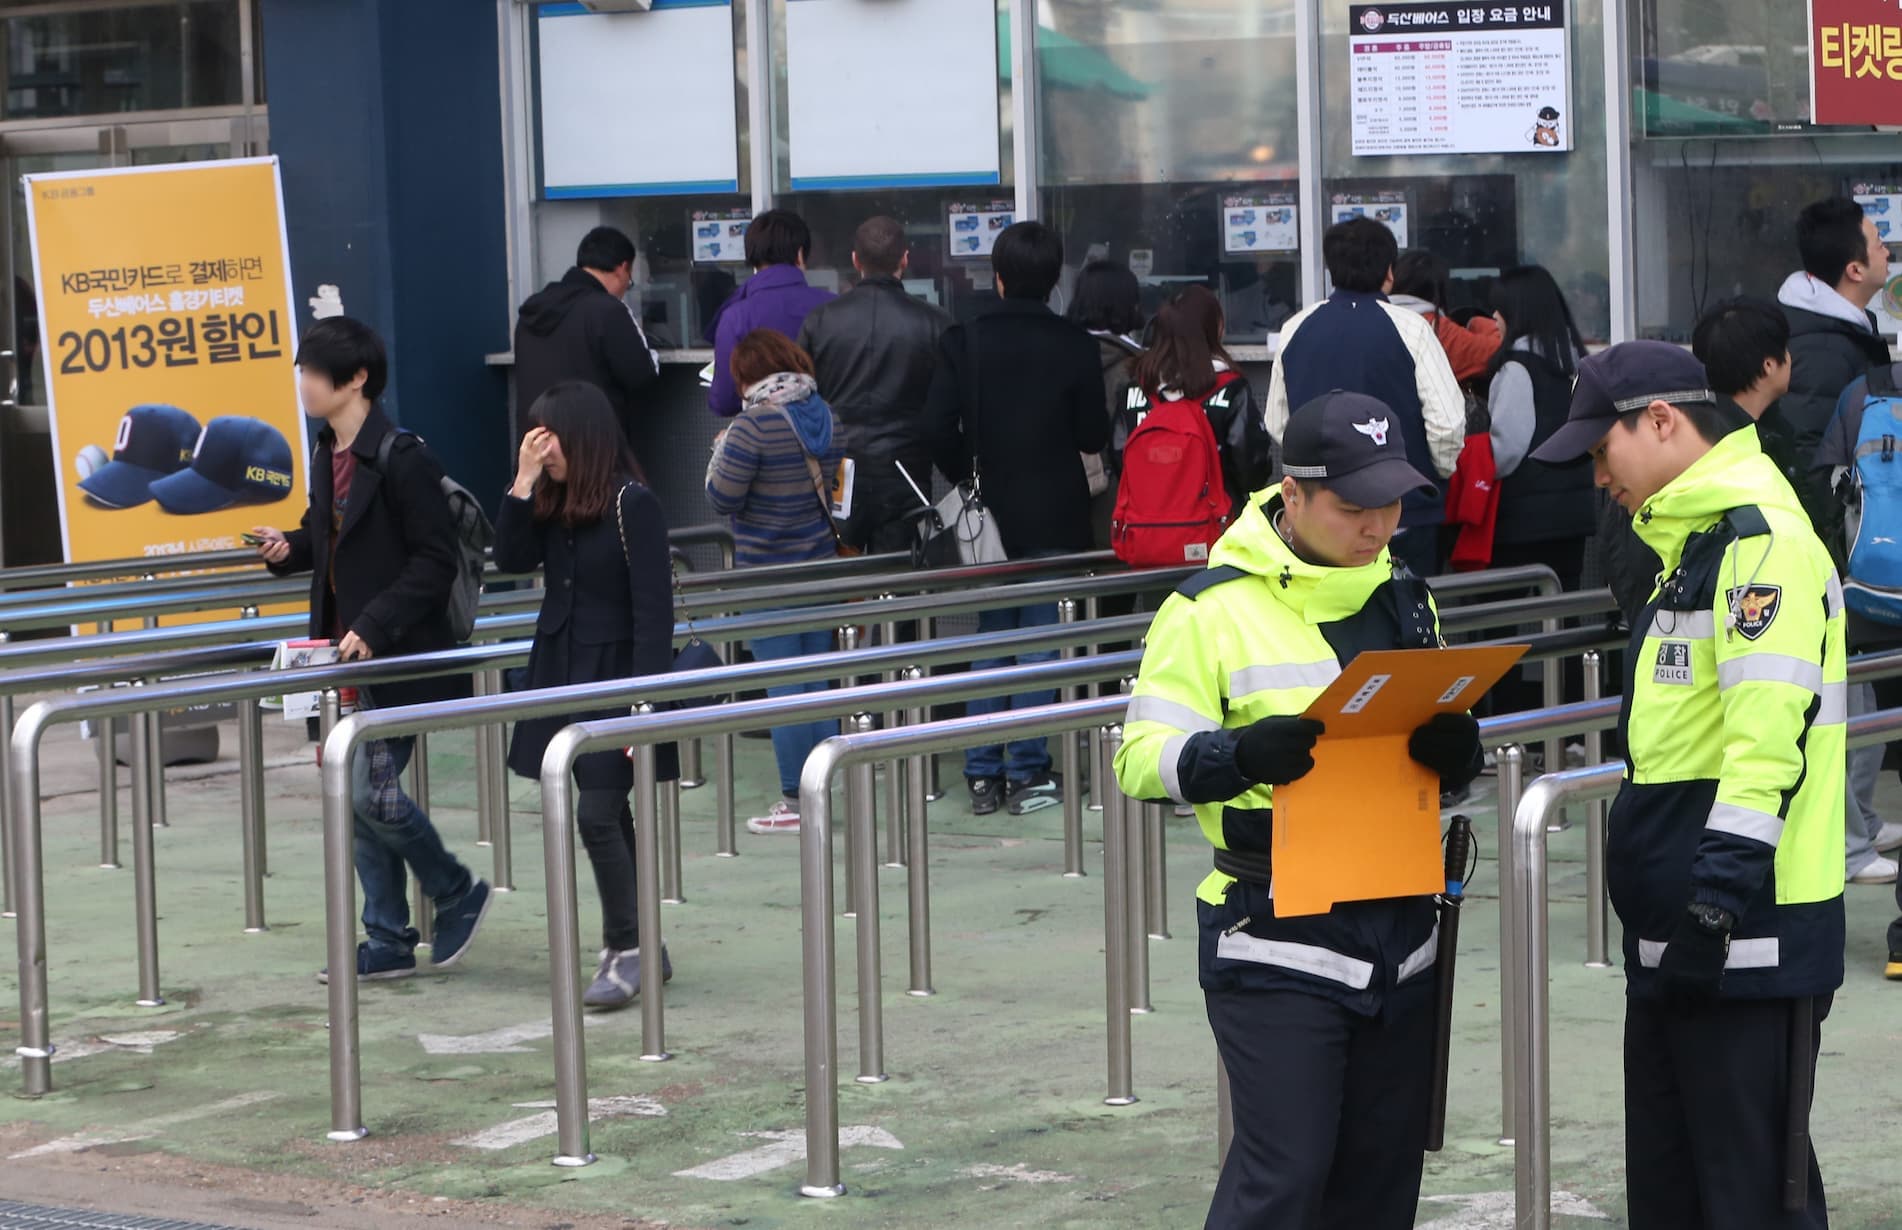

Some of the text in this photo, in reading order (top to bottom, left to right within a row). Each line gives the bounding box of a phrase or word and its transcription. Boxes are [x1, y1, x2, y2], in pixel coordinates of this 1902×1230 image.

[1387, 12, 1450, 25] 두산베어스
[1457, 8, 1485, 24] 입장
[1489, 7, 1518, 22] 요금
[1523, 5, 1551, 21] 안내
[62, 256, 262, 294] KB국민카드로 결제하면
[57, 309, 282, 375] 2013원 할인
[1659, 644, 1687, 666] 경찰
[1655, 668, 1688, 680] POLICE
